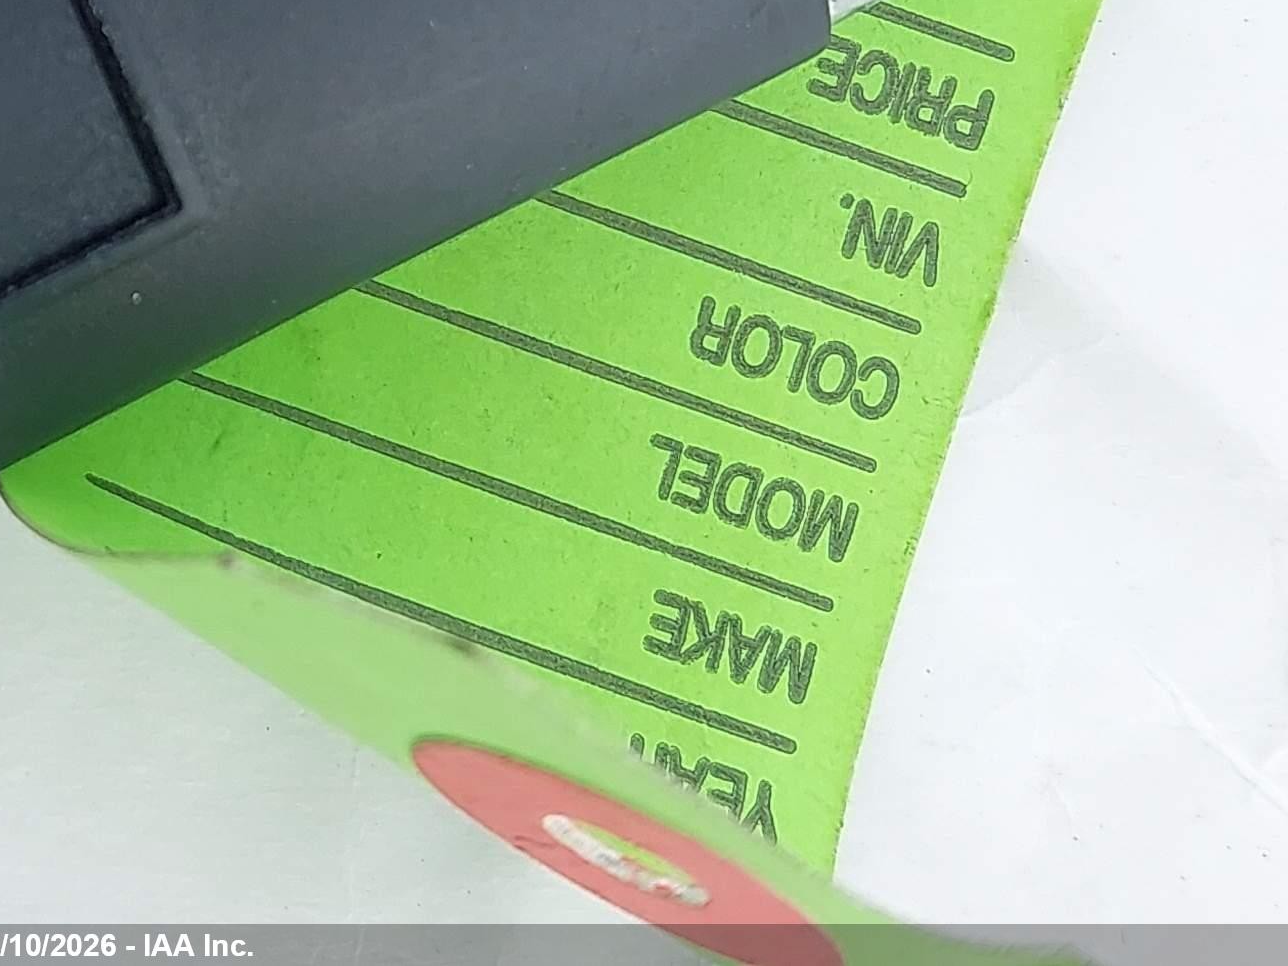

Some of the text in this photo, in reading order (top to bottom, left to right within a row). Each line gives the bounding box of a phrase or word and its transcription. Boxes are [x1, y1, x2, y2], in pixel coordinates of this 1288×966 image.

[806, 35, 995, 151] PRICE
[838, 192, 940, 287] VIN.
[689, 295, 900, 421] COLOR
[649, 432, 859, 563] MODEL
[642, 588, 818, 705] MAKE
[630, 732, 778, 847] YEA
